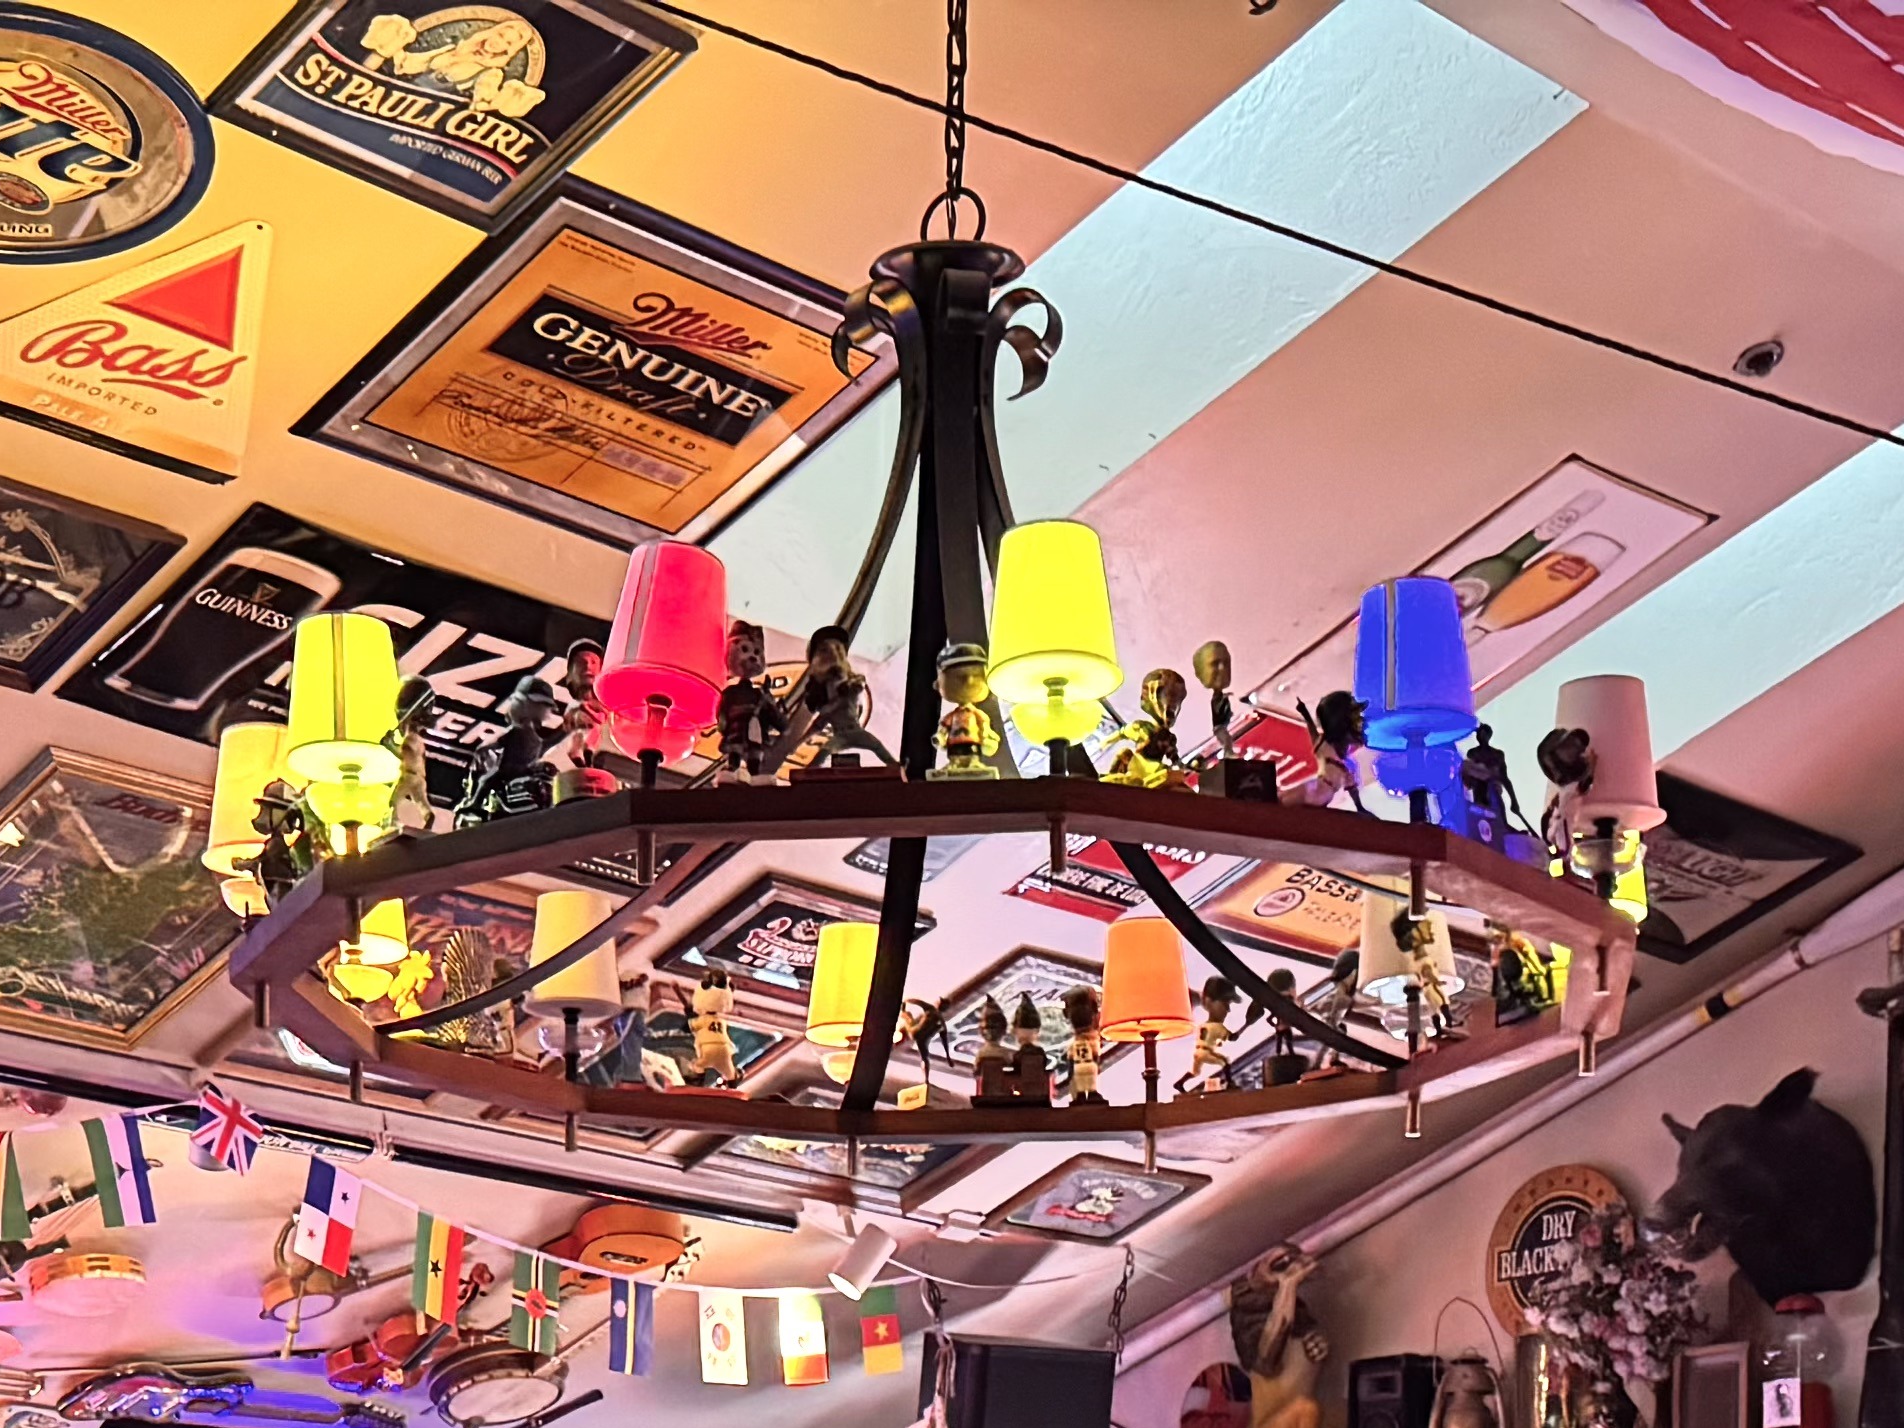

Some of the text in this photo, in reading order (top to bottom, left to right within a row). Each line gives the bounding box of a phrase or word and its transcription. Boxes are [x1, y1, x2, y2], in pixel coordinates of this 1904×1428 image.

[9, 60, 131, 142] Miller
[341, 73, 537, 165] PAULI GIRL
[19, 318, 249, 398] Bass
[633, 291, 773, 359] Miller
[46, 371, 159, 417] IMPORTED
[533, 310, 771, 419] GENUINE
[194, 587, 294, 633] GUINNESS
[1542, 1210, 1577, 1242] DRY
